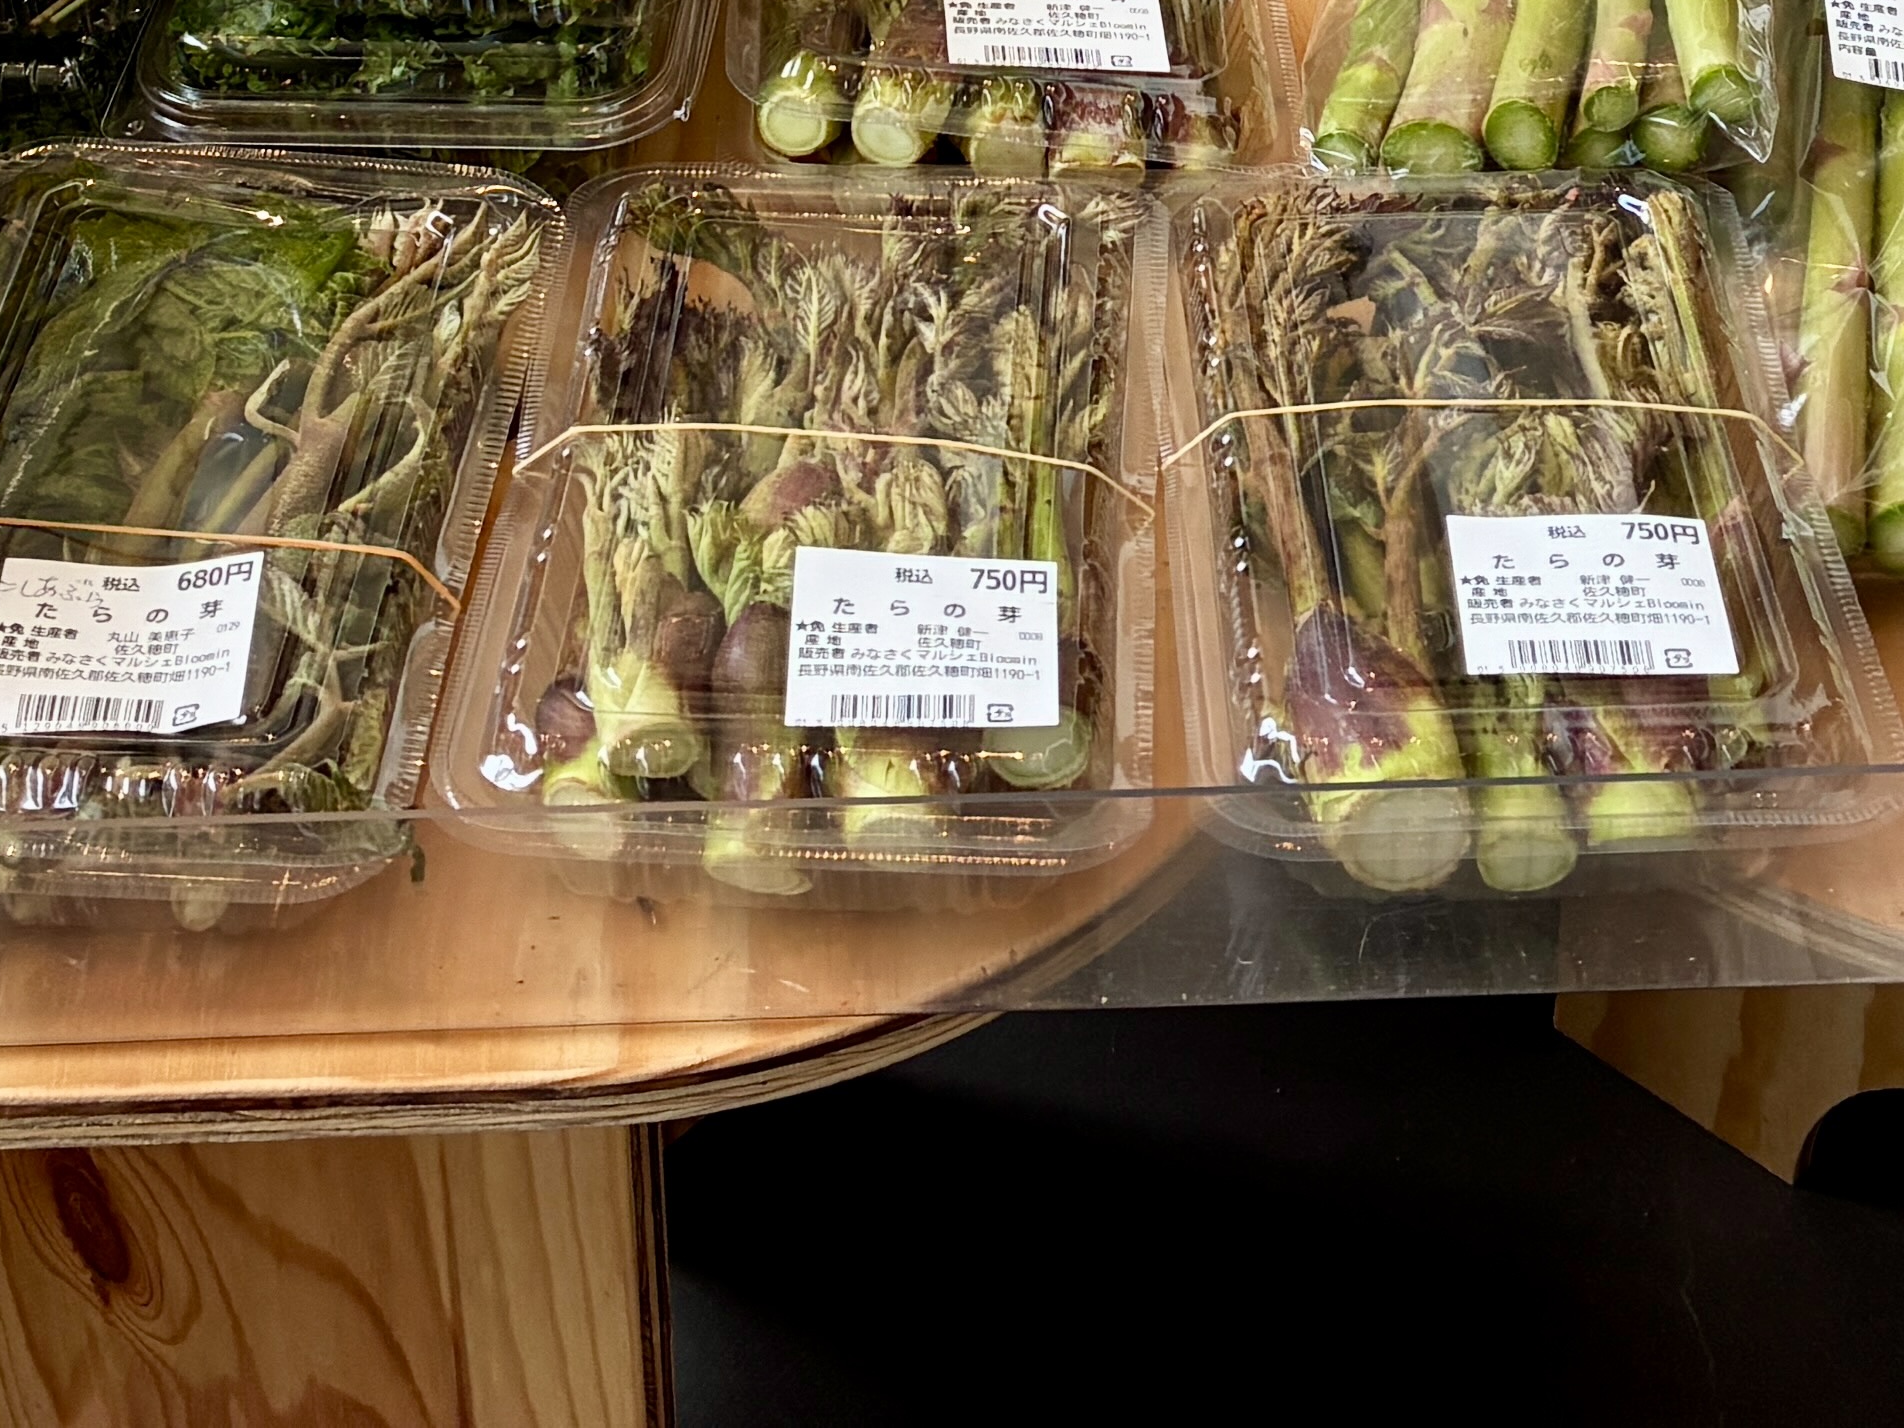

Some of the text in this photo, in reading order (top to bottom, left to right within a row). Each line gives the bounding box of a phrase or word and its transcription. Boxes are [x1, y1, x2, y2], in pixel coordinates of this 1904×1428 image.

[1548, 522, 1700, 545] 税込 750円
[1493, 553, 1680, 570] たらの芽
[103, 576, 141, 592] 税込
[178, 560, 255, 592] 680円
[895, 567, 1049, 594] 税込 750円
[1496, 575, 1542, 586] 生産者
[1579, 574, 1611, 585] 新津
[1582, 586, 1646, 598] 佐久穂町
[36, 600, 224, 624] たらの芽
[833, 597, 1023, 623] たらの芽
[1467, 597, 1705, 611] 販売者 みなさくマルシェBloomin
[1470, 612, 1711, 626] 長野県南佐久郡佐久穂町畑1190-1
[32, 621, 241, 643] 生産者 丸山 美恵子 0129
[831, 622, 879, 634] 生産者
[917, 624, 948, 636] 新津
[114, 643, 179, 657] 佐久穂町
[918, 637, 982, 650] 佐久穂町
[46, 647, 231, 668] みなさくマルシェBloomin
[798, 647, 1037, 665] 販売者 みなさくマルシェBloomin
[797, 665, 1041, 681] 長野県南佐久郡佐久穂町畑1190-1
